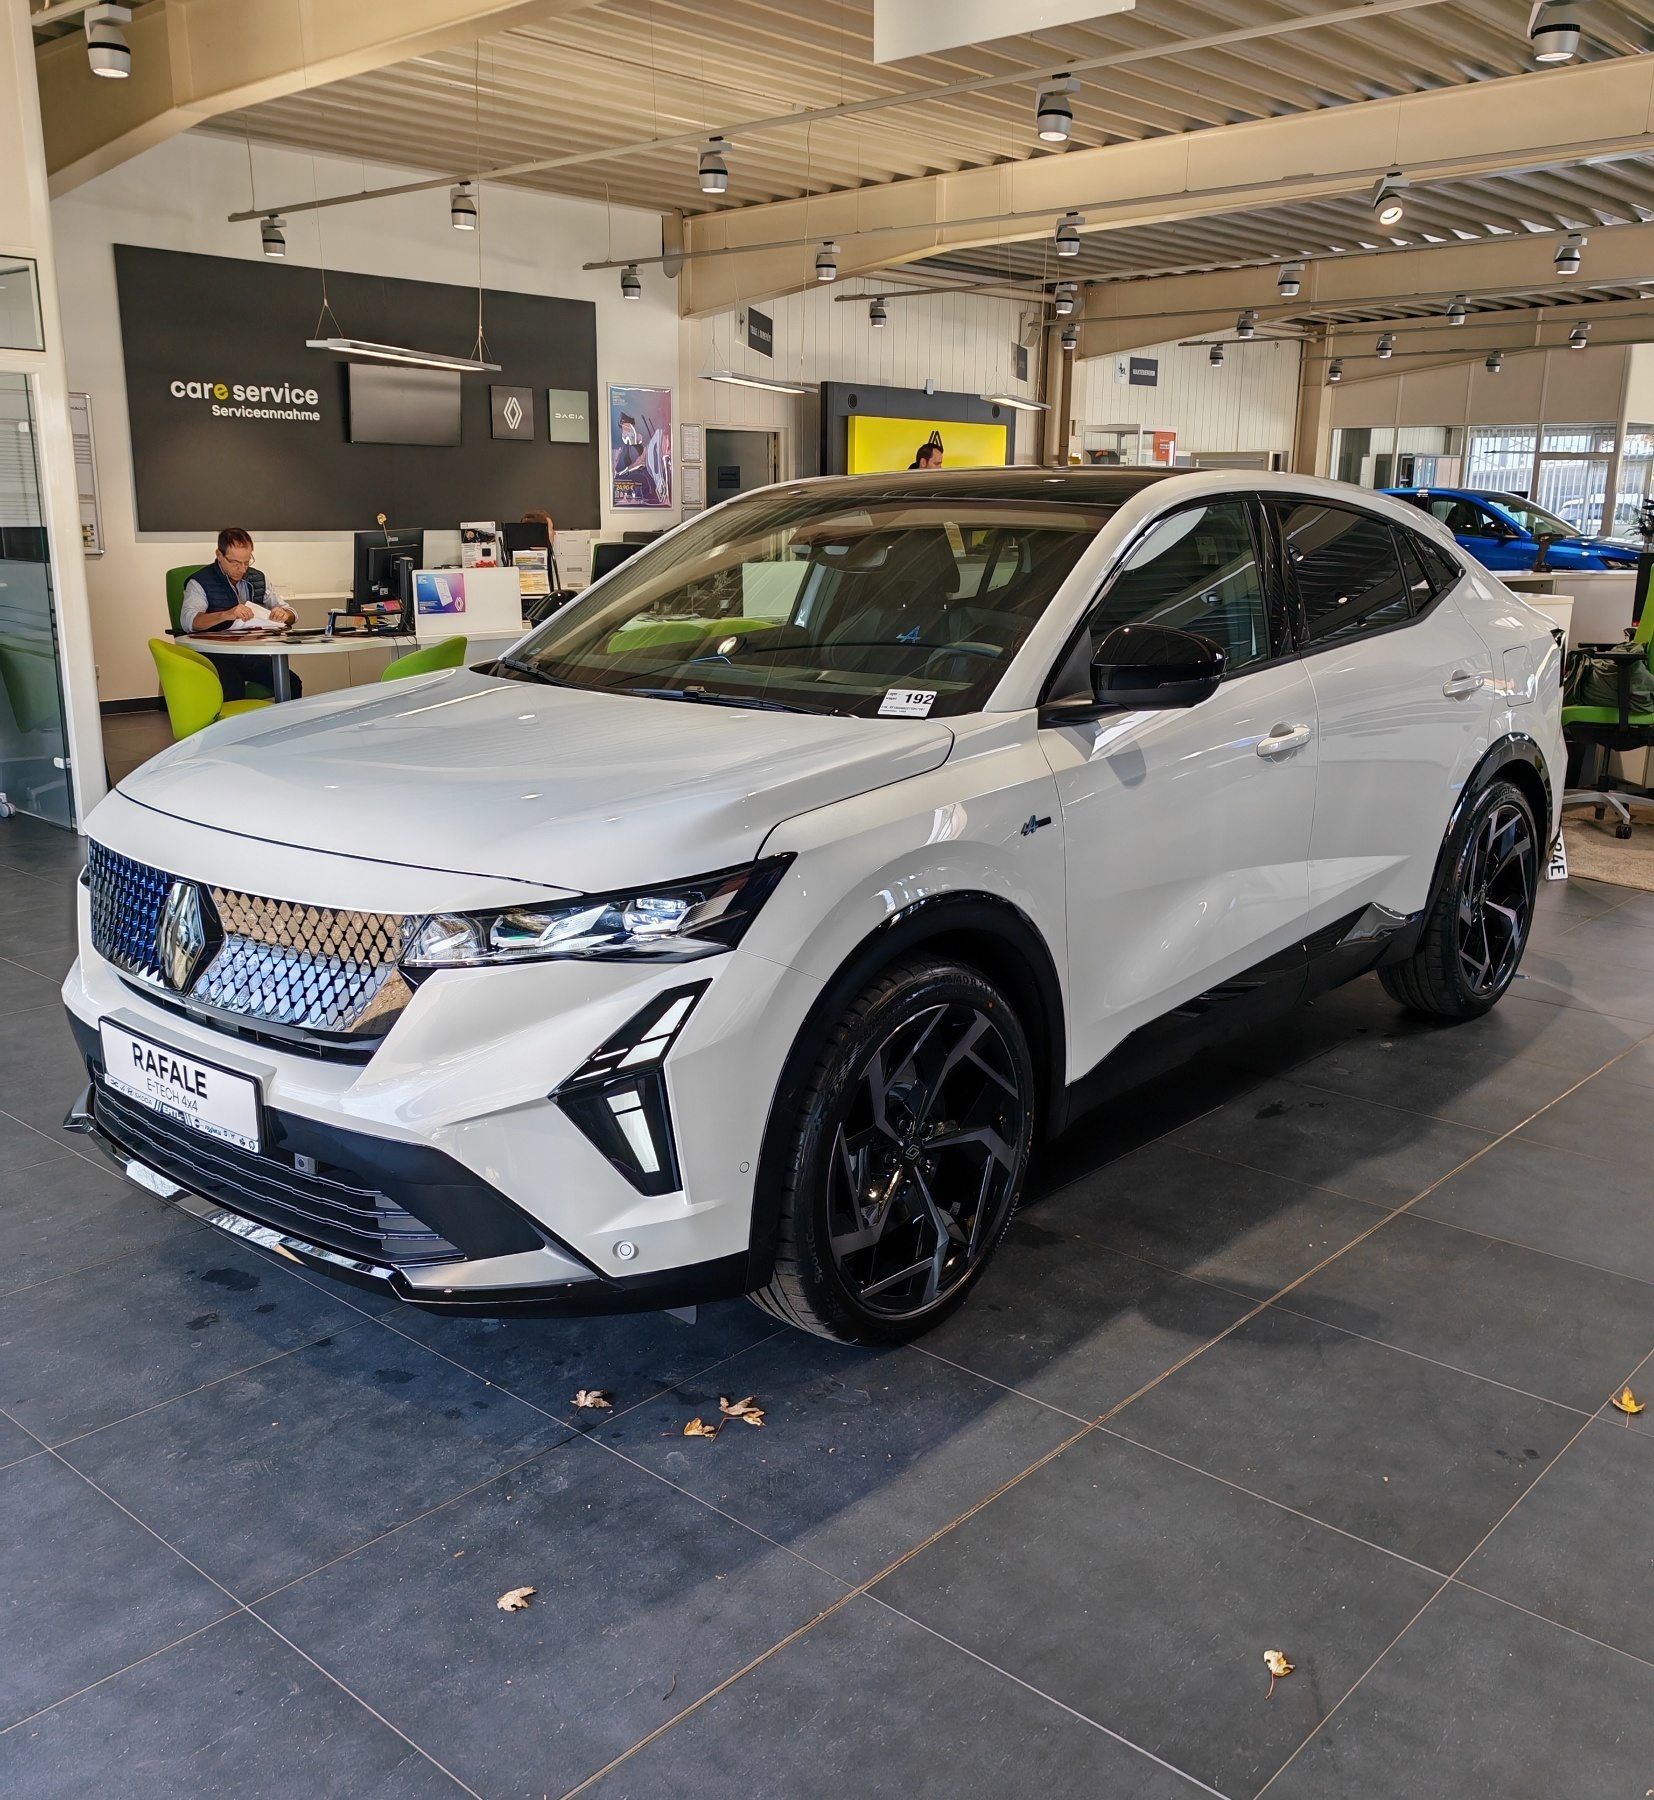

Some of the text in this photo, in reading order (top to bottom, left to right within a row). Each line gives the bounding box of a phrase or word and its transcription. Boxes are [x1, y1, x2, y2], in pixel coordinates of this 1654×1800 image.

[170, 380, 319, 405] care service
[212, 404, 321, 421] Serviceannahme
[554, 412, 585, 420] DACIA
[905, 693, 935, 705] 192
[132, 1041, 208, 1100] RAFALE
[146, 1077, 199, 1113] E-TECH 4x4
